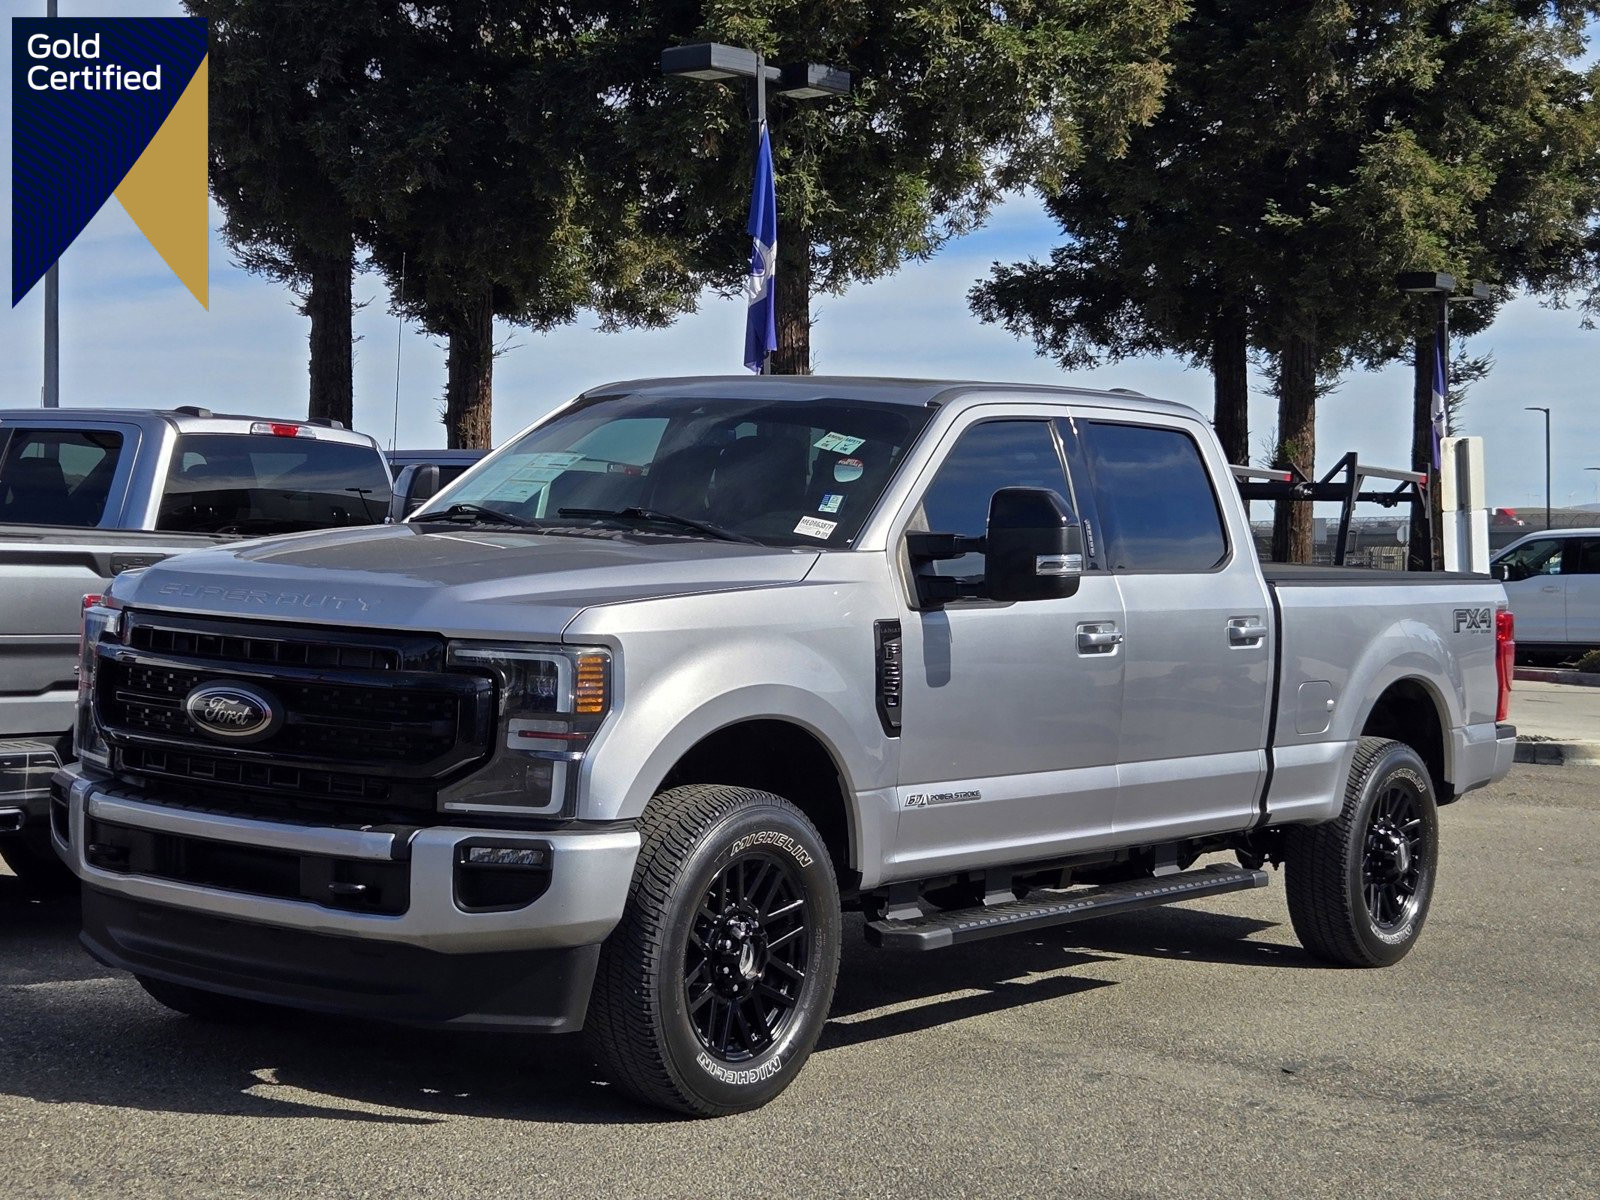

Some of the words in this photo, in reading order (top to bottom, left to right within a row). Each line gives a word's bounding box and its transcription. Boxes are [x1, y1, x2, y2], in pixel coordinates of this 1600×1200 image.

[159, 582, 270, 605] SUPER
[275, 592, 382, 612] DUTY
[1453, 608, 1492, 634] FX4
[204, 696, 252, 727] Ford
[954, 789, 981, 799] STROKE
[730, 830, 814, 869] MICHELIN
[697, 1051, 782, 1085] MICHELIN
